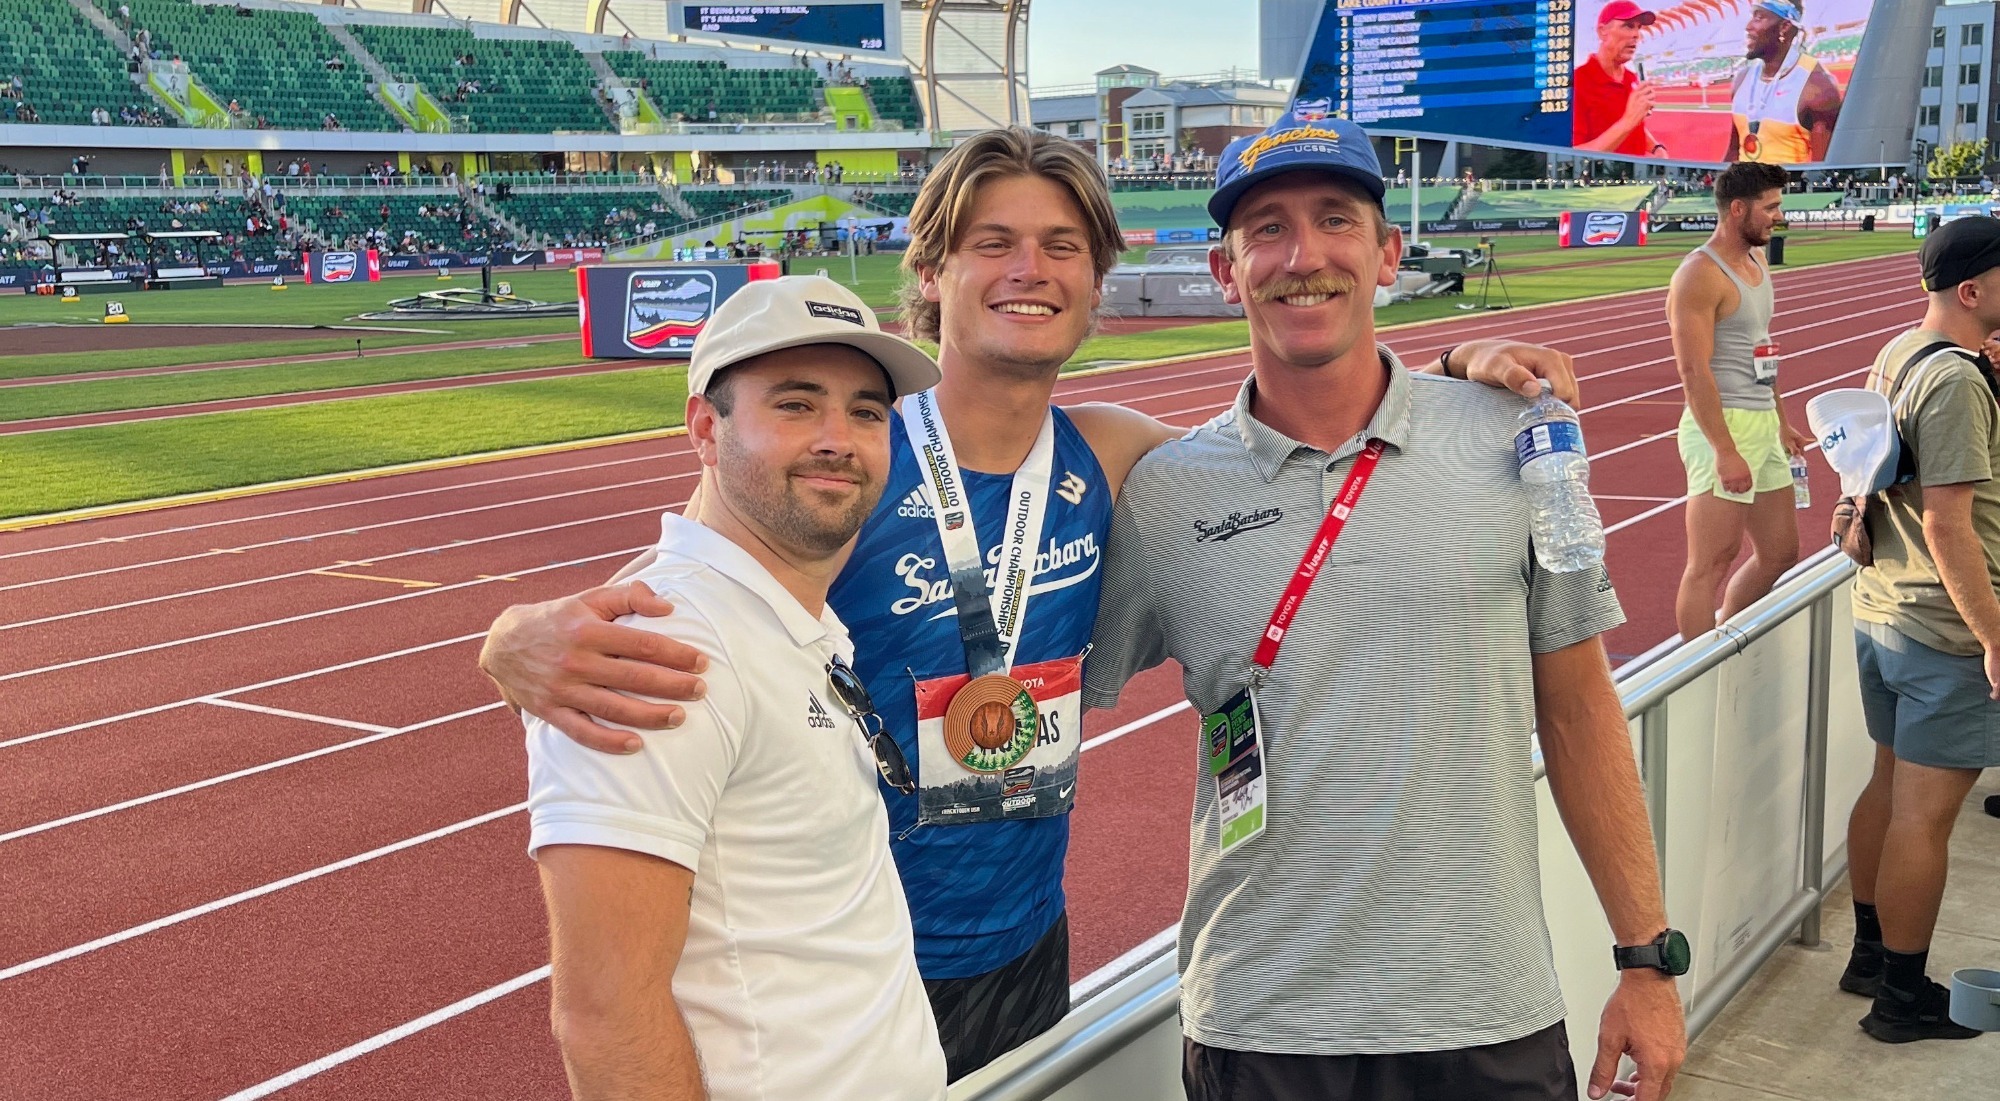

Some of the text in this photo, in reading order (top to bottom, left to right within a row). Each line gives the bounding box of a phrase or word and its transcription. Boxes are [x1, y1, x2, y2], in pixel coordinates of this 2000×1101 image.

[710, 7, 734, 15] BEING
[751, 6, 765, 14] ON
[765, 6, 781, 14] THE
[717, 15, 758, 23] AMAZING.
[1340, 17, 1348, 26] 1
[1340, 29, 1348, 39] 2
[1340, 41, 1348, 51] 3
[1340, 53, 1348, 63] 4
[1340, 65, 1348, 75] 5
[1340, 77, 1348, 87] 6
[1340, 89, 1348, 99] 7
[1340, 101, 1348, 111] 8
[1238, 124, 1340, 173] Gauchos
[1294, 145, 1326, 153] UCSB
[1785, 211, 1806, 222] USA
[1808, 209, 1844, 222] TRACK
[1845, 209, 1853, 220] &
[254, 265, 278, 273] USATF
[63, 287, 76, 296] 30
[499, 284, 511, 295] 30
[108, 303, 123, 314] 20
[813, 304, 858, 320] adidas
[917, 390, 960, 506] OUTDOOR CHAMPIONSH
[1343, 475, 1363, 504] TOYOTA
[898, 504, 936, 518] adid
[1194, 507, 1281, 542] Santa Barbara
[1311, 538, 1329, 568] USATF
[997, 491, 1031, 635] OUTDOOR CHAMPIONSHIPS
[1276, 595, 1297, 625] TOYOTA
[1020, 676, 1045, 690] OTA
[808, 713, 835, 728] adidas
[1002, 796, 1037, 807] OUTDOOR
